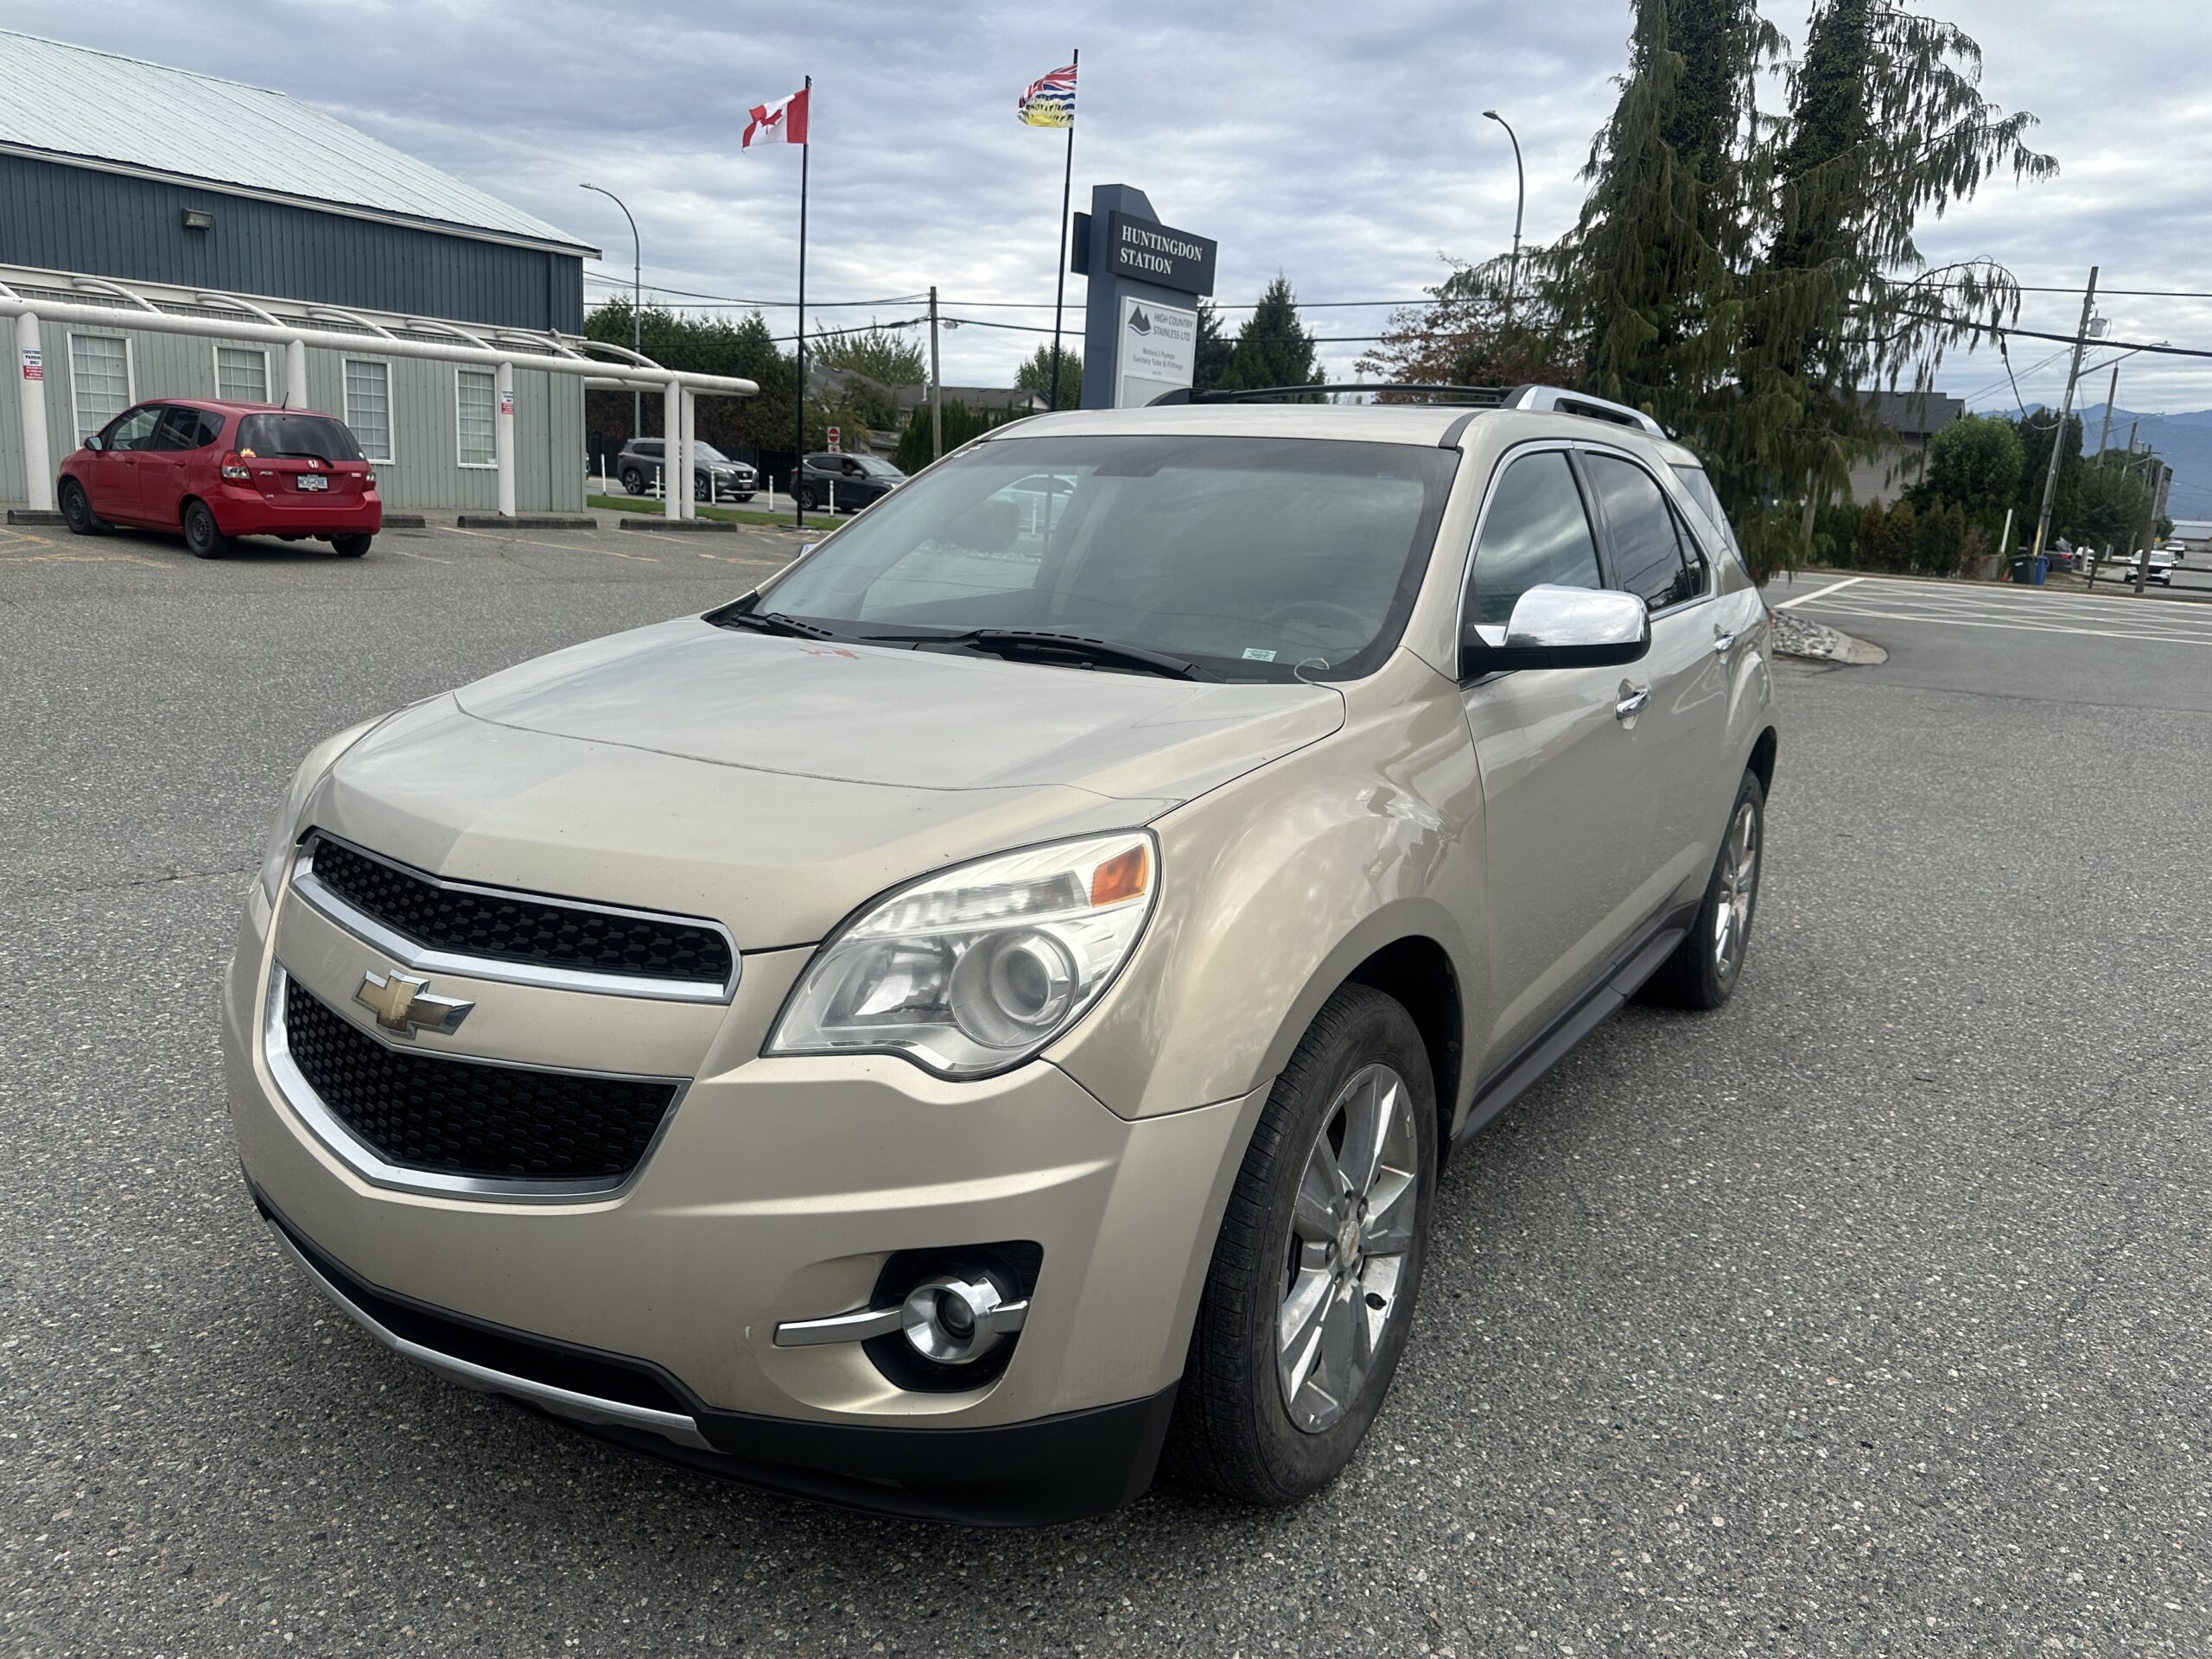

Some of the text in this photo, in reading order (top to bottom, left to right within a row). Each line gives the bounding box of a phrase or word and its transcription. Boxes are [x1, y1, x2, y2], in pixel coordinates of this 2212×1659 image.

[1122, 225, 1203, 262] HUNTINGDON
[1120, 247, 1173, 275] STATION
[1154, 313, 1193, 328] HIGH COUNTRY
[1153, 326, 1192, 342] STAINLESS LTD
